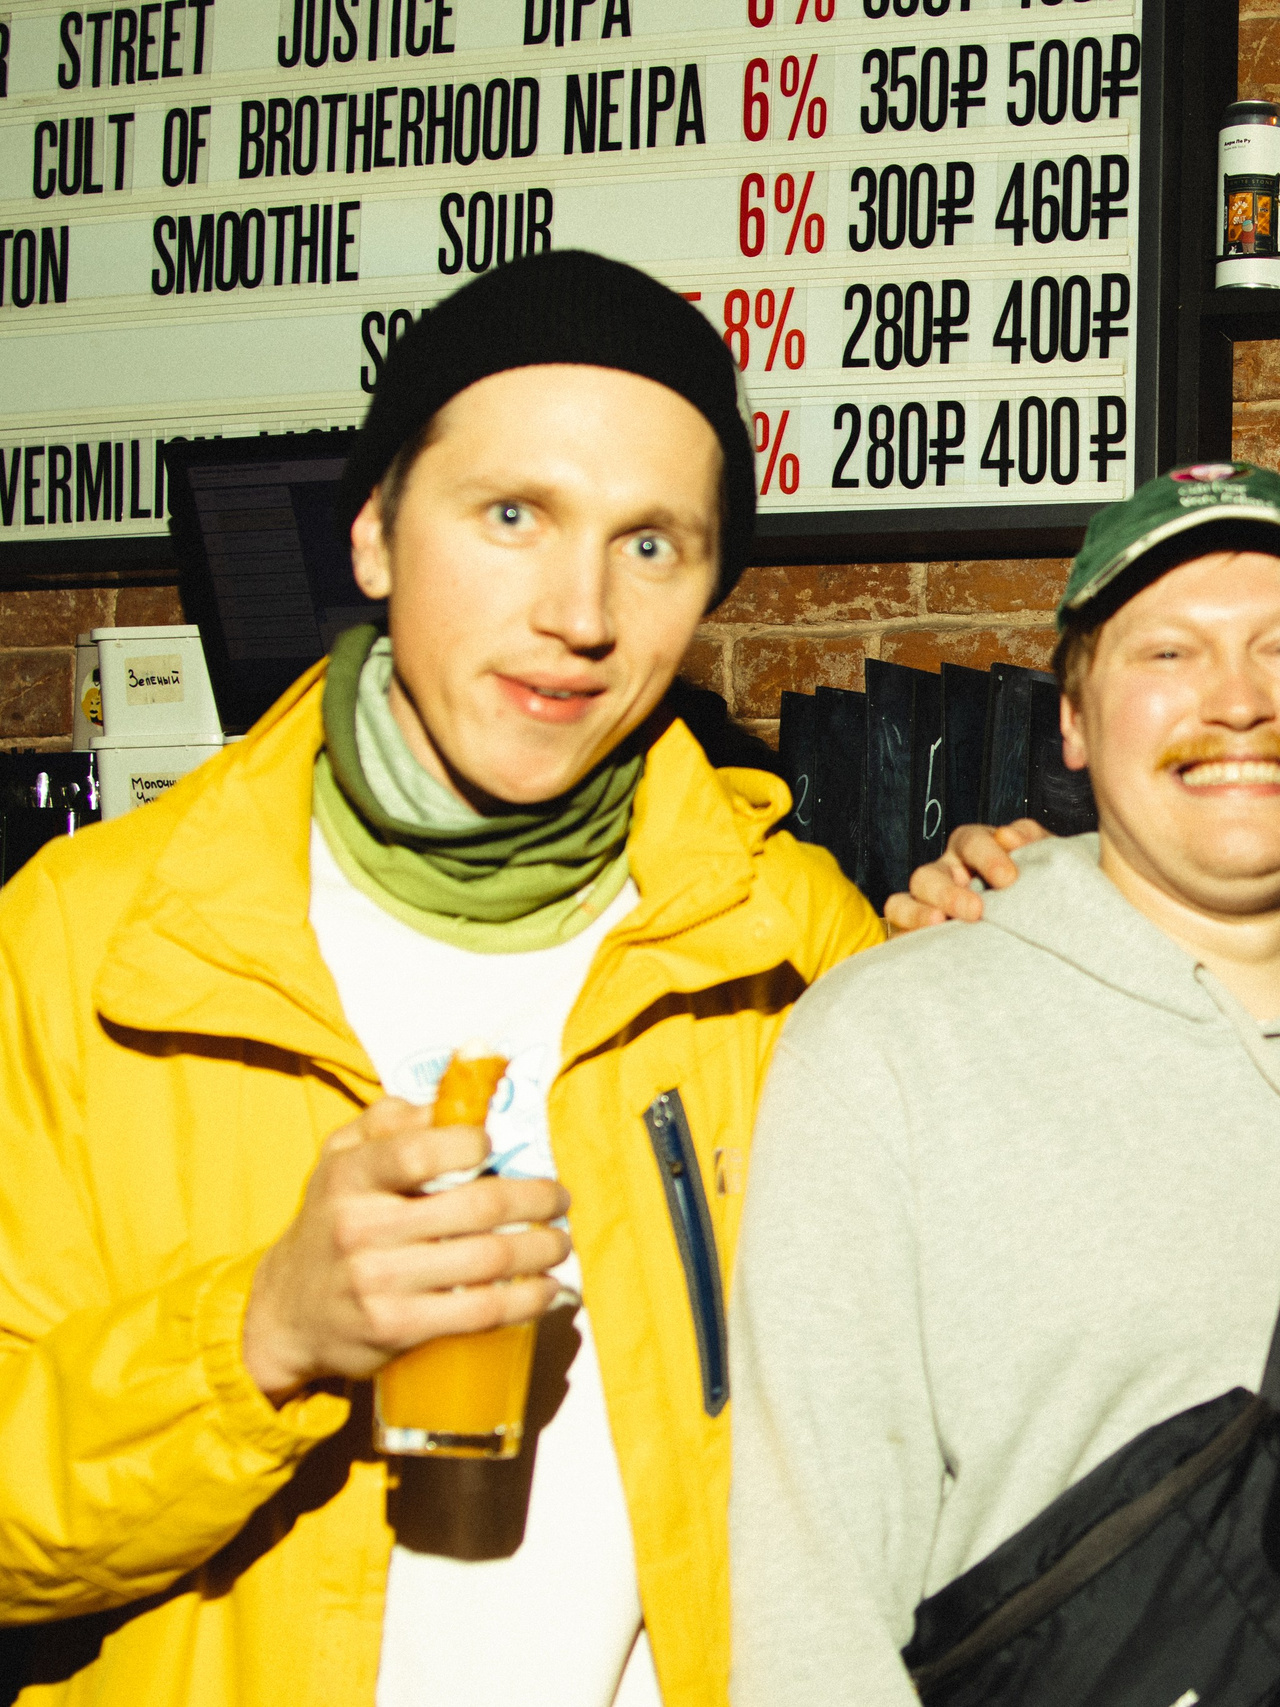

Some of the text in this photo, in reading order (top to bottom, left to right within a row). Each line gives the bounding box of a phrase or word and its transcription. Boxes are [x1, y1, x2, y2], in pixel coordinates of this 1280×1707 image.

[58, 0, 214, 90] STREET
[277, 0, 455, 68] JUSTICE
[34, 112, 134, 199] CULT
[163, 106, 211, 187] OF
[239, 77, 540, 179] BROTHERHOOD
[563, 63, 705, 155] NEIPA
[743, 53, 827, 141] 6%
[152, 201, 361, 296] SMOOTHIE
[438, 187, 553, 275] SOUR
[738, 171, 825, 257] 6%
